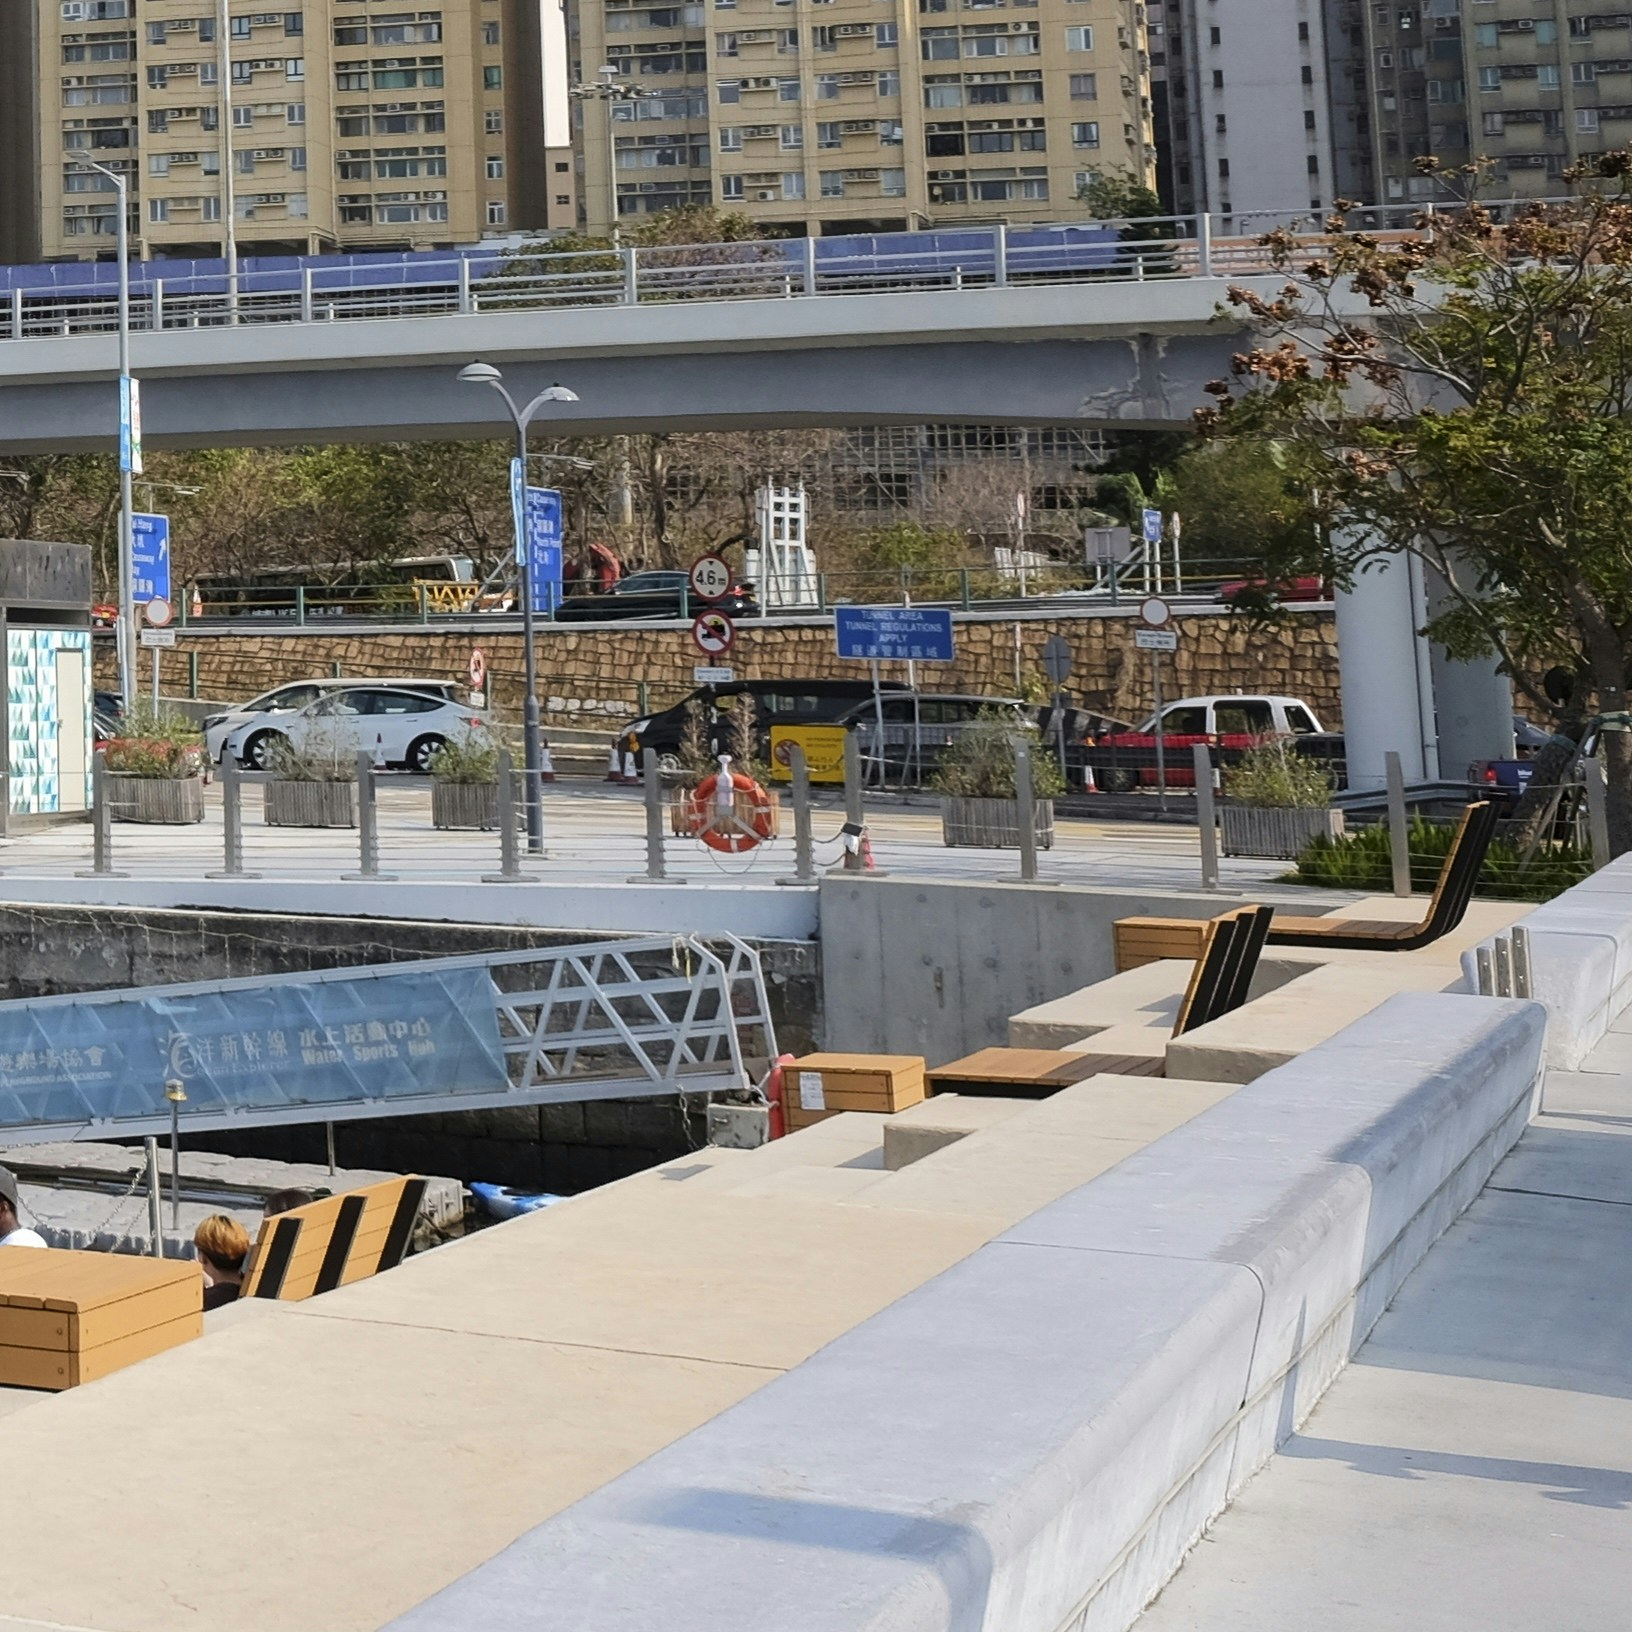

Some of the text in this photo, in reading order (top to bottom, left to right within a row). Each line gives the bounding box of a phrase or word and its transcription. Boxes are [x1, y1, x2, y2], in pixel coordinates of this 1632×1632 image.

[862, 611, 924, 620] TUNNEL AREA
[845, 621, 943, 632] TUNNEL REGULATIONS
[878, 634, 908, 643] APPLY
[298, 1018, 432, 1047] 水上活動中心
[301, 1039, 436, 1066] Water Sports Hub
[56, 1071, 112, 1083] ASSOCIATION
